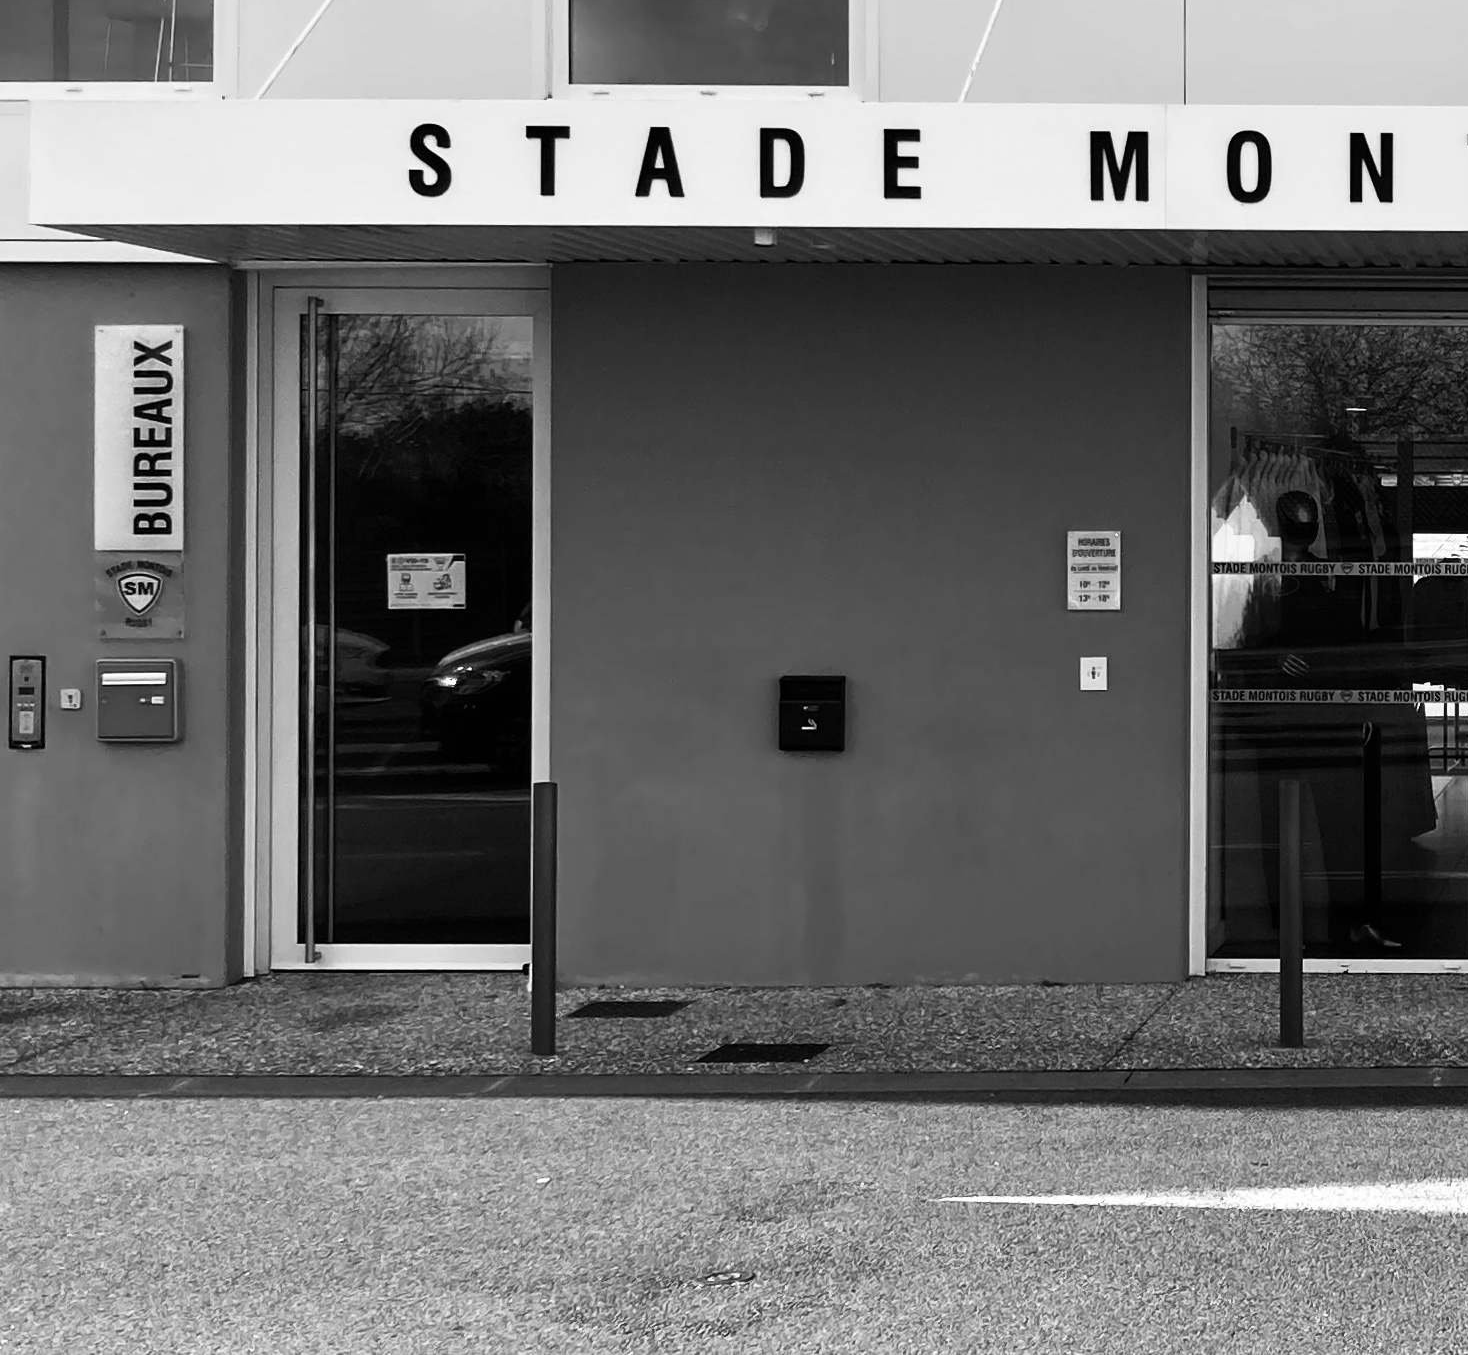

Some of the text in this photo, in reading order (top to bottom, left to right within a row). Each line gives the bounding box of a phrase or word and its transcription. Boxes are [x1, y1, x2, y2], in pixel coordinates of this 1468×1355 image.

[408, 124, 922, 199] STADE
[133, 340, 174, 535] BUREAUX
[1213, 563, 1246, 574] STADE
[1249, 563, 1297, 574] MONTOIS
[1300, 563, 1335, 575] RUGBY
[1358, 563, 1391, 574] STADE
[1394, 564, 1441, 575] MONTOIS
[123, 582, 154, 595] SM
[1212, 690, 1245, 701] STADE
[1248, 690, 1296, 701] MONTOIS
[1300, 690, 1335, 701] RUGBY
[1358, 691, 1390, 702] STADE
[1393, 691, 1441, 702] MONTOIS
